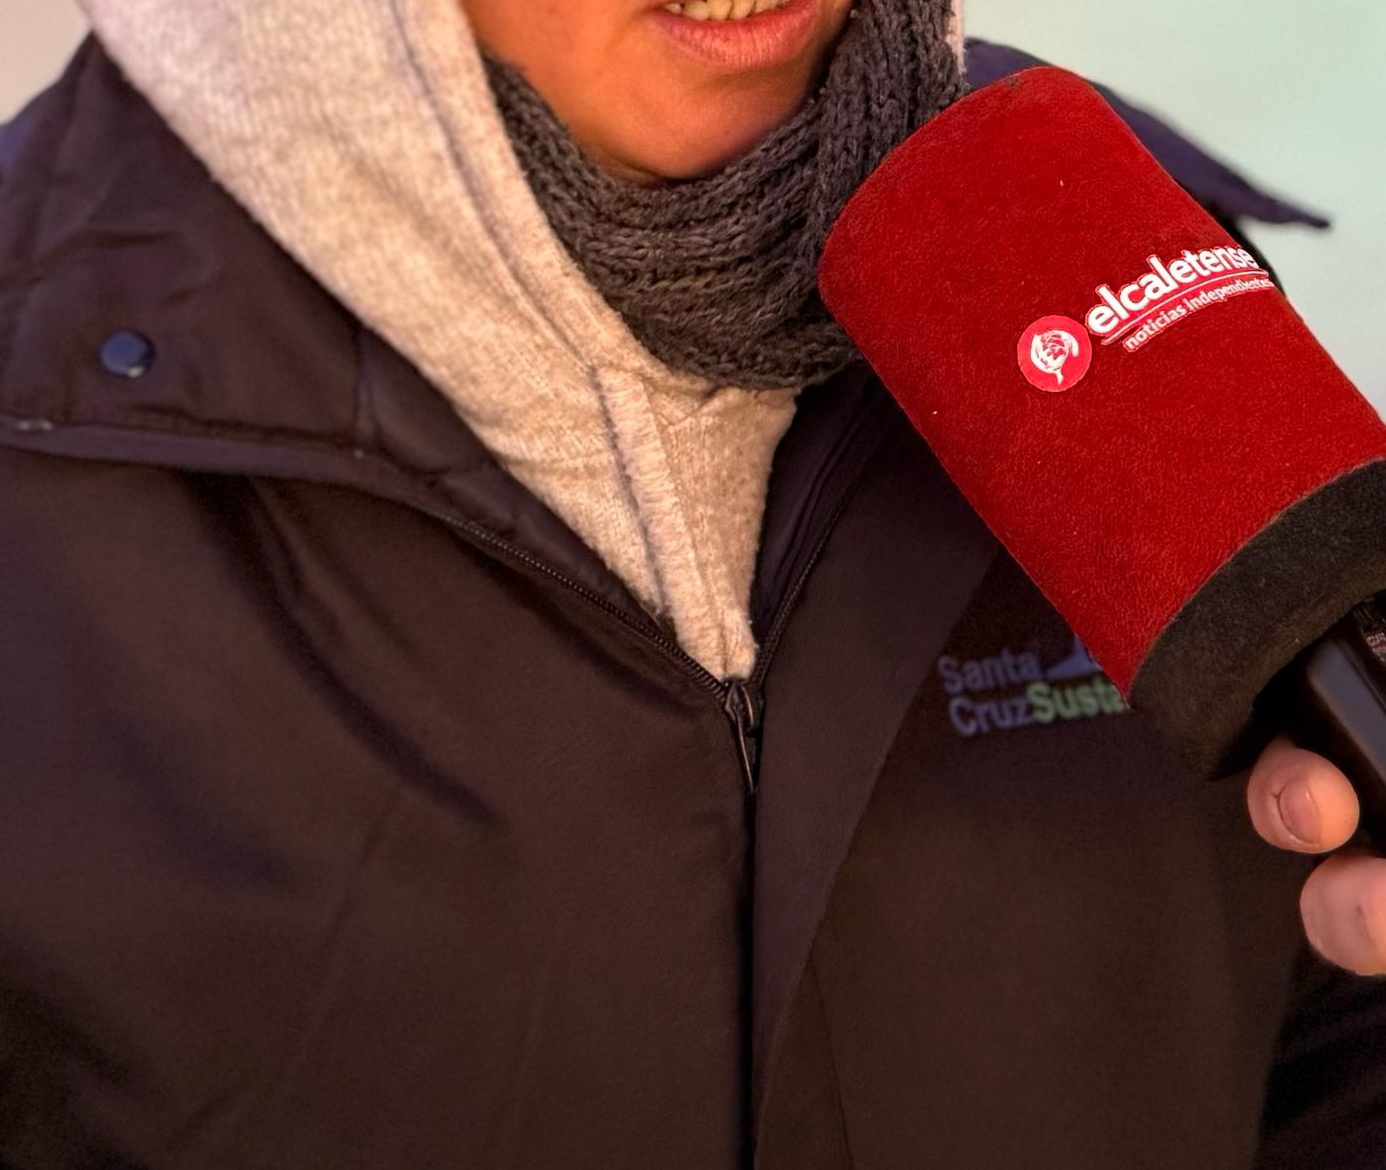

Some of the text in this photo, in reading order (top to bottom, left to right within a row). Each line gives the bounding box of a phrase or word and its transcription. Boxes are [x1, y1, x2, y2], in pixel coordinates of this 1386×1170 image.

[1087, 246, 1260, 334] elcaletense
[1124, 304, 1186, 350] noticias
[937, 647, 1042, 695] Santa
